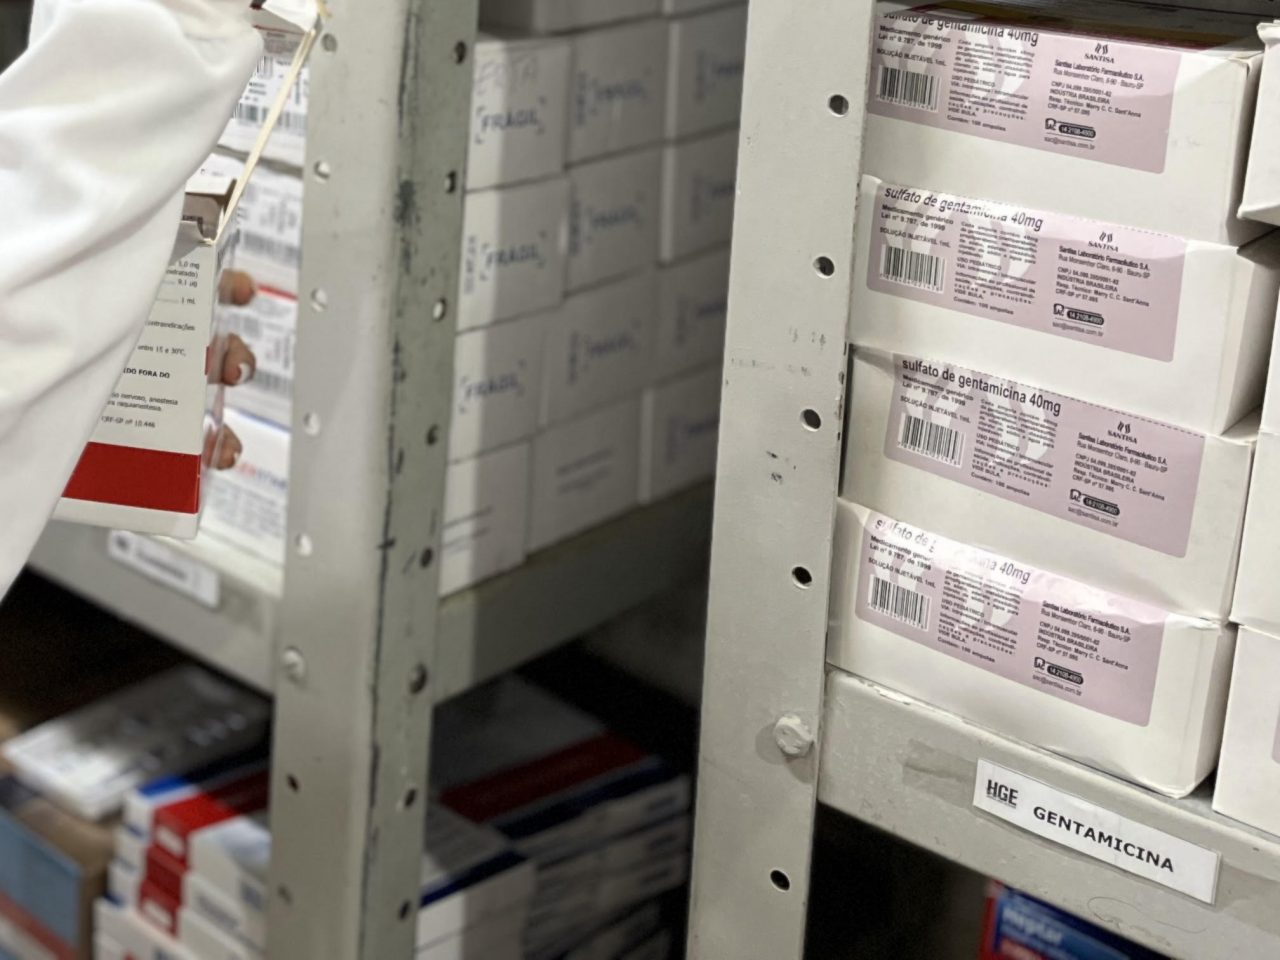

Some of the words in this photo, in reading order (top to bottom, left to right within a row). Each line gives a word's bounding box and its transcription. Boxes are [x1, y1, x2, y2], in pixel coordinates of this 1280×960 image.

[884, 187, 921, 204] sulfato
[923, 194, 937, 207] de
[1011, 211, 1043, 232] 40mg
[138, 369, 157, 378] FORA
[159, 371, 170, 379] DO
[902, 359, 939, 378] sulfato
[942, 368, 955, 382] de
[958, 374, 1026, 403] gentamicina
[1029, 393, 1061, 417] 40mg
[999, 562, 1031, 584] 40mg
[987, 779, 1019, 805] HGE
[1033, 806, 1174, 872] GENTAMICINA
